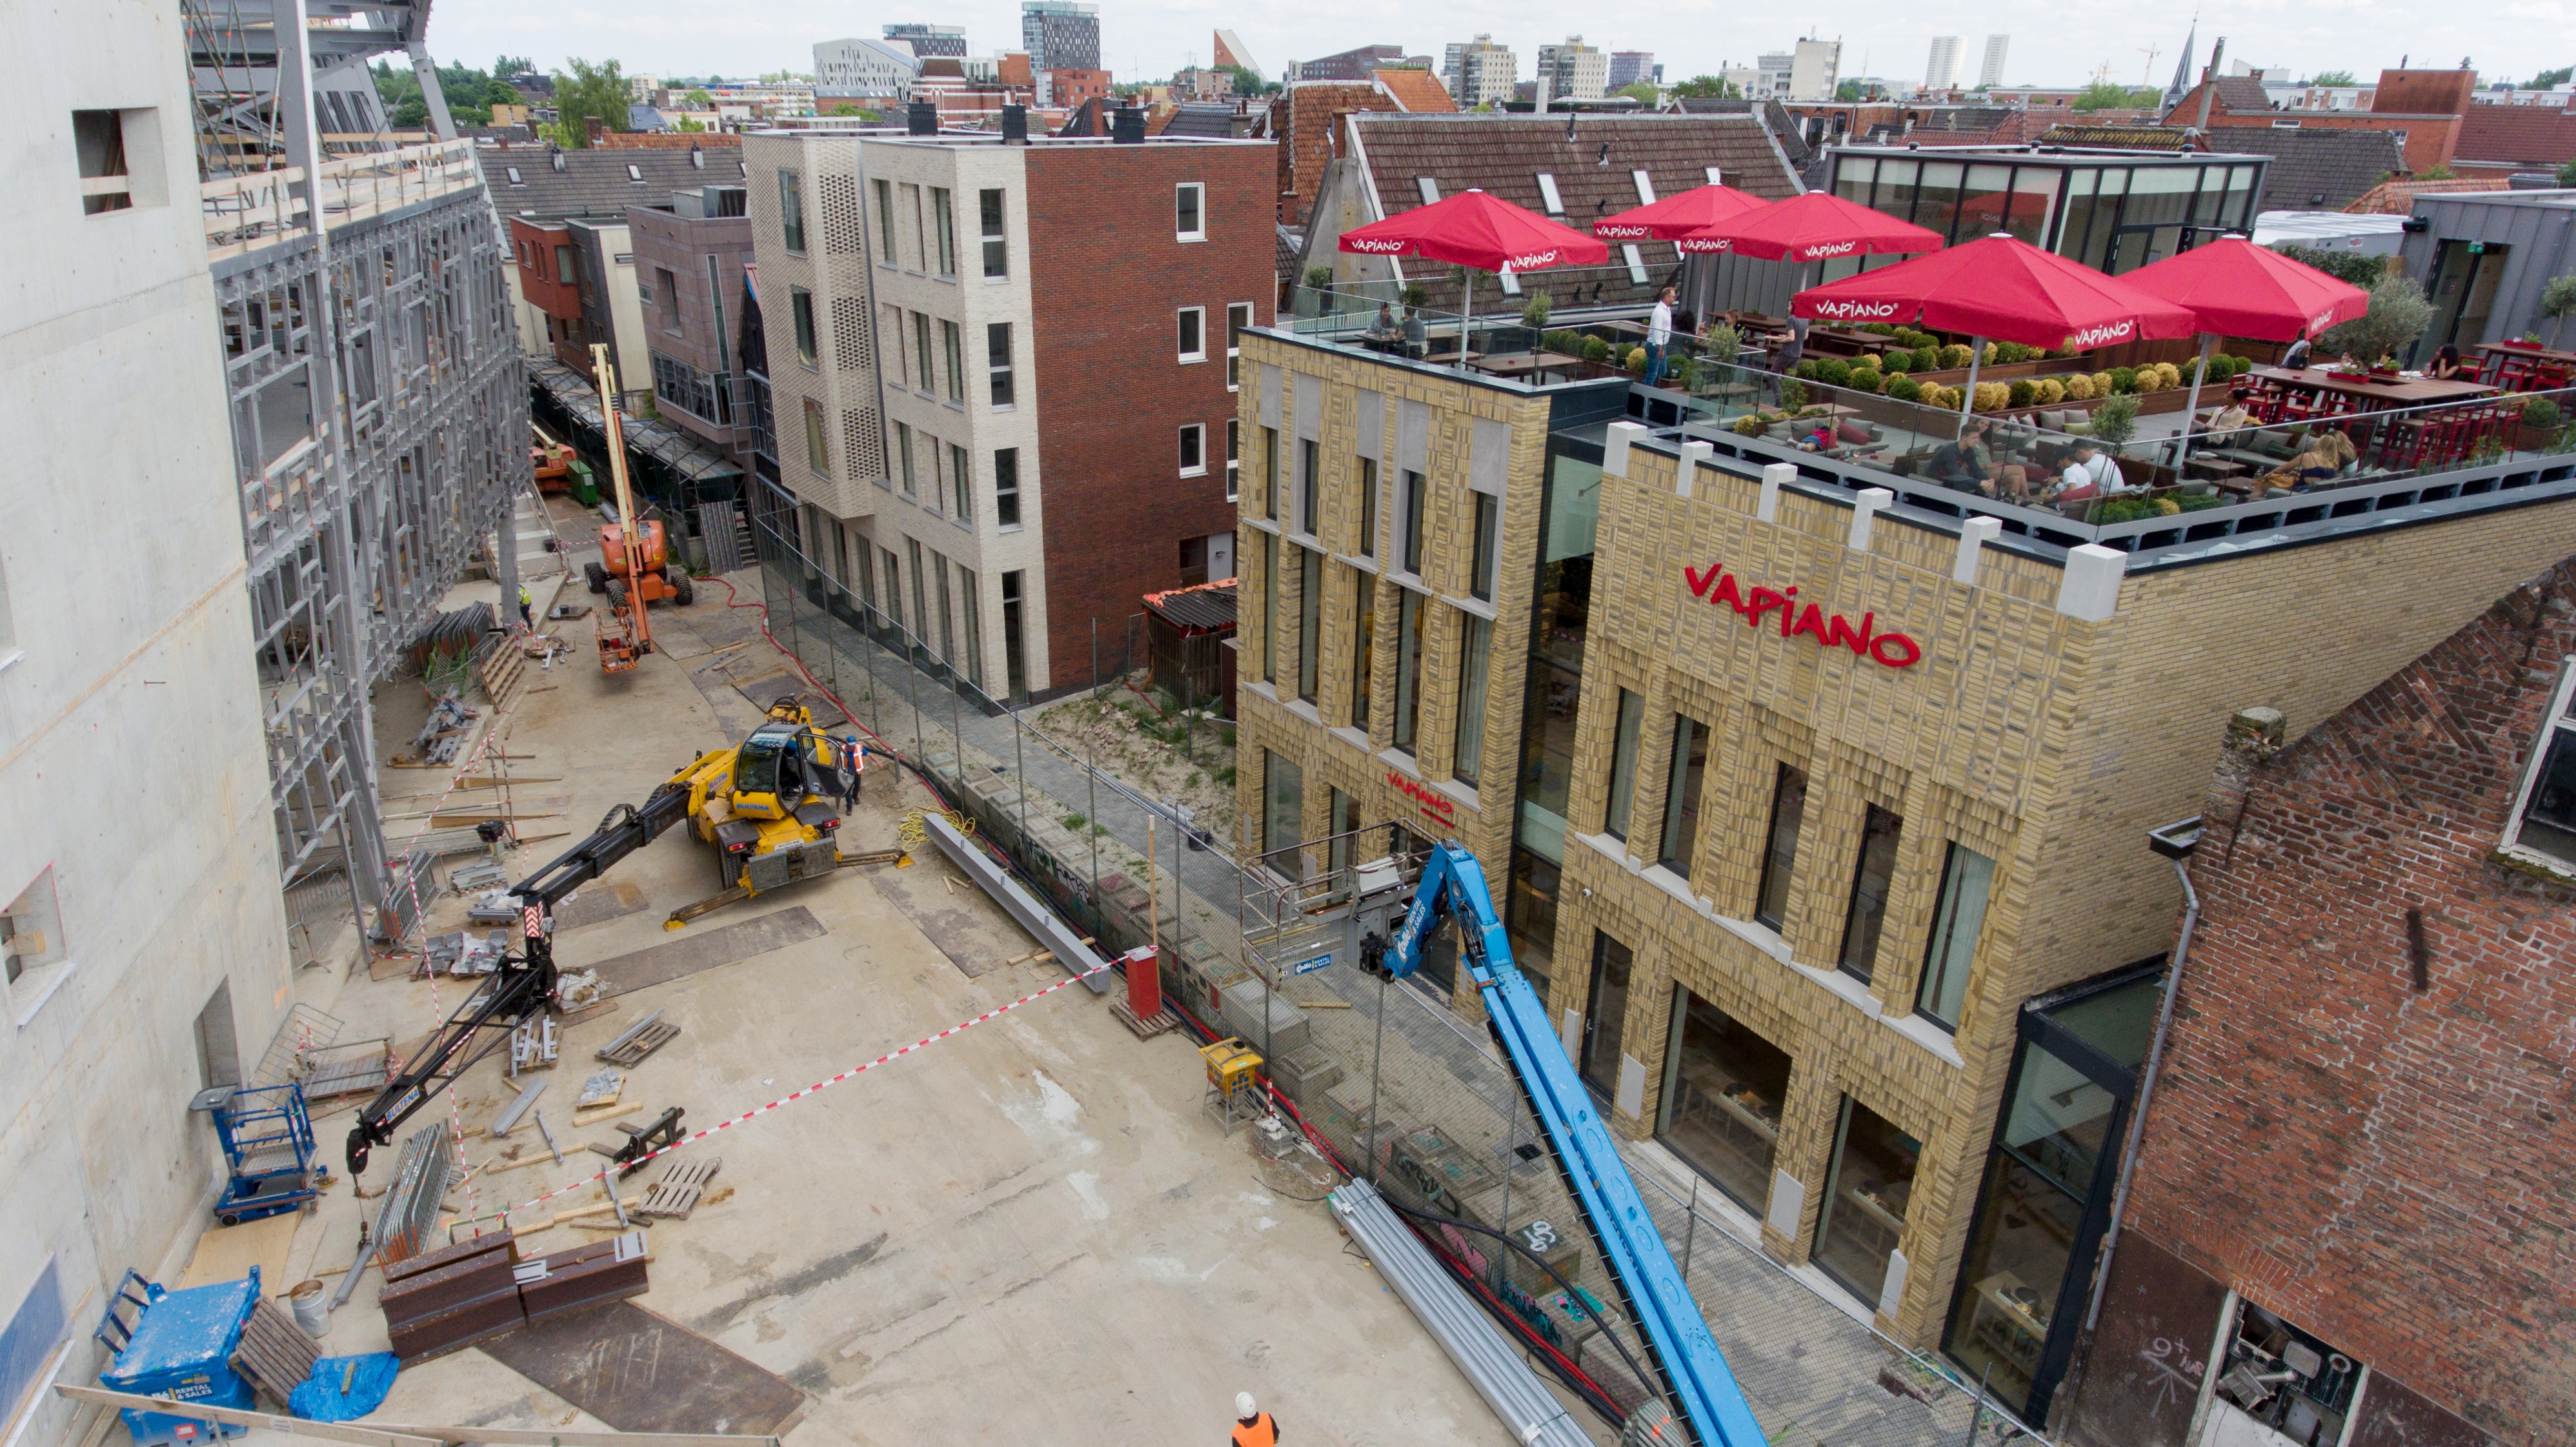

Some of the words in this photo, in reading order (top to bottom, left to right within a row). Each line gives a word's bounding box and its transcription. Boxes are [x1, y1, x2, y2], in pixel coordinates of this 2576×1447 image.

[1816, 299, 1894, 318] VAPiANO
[2075, 321, 2130, 345] VAPiANO
[1685, 563, 1921, 667] VAPiANO
[1409, 896, 1422, 926] RENTAL
[1414, 904, 1426, 929] SALES
[387, 1089, 419, 1122] BULTENA
[175, 1384, 211, 1395] RENTAL
[185, 1388, 213, 1399] SALES
